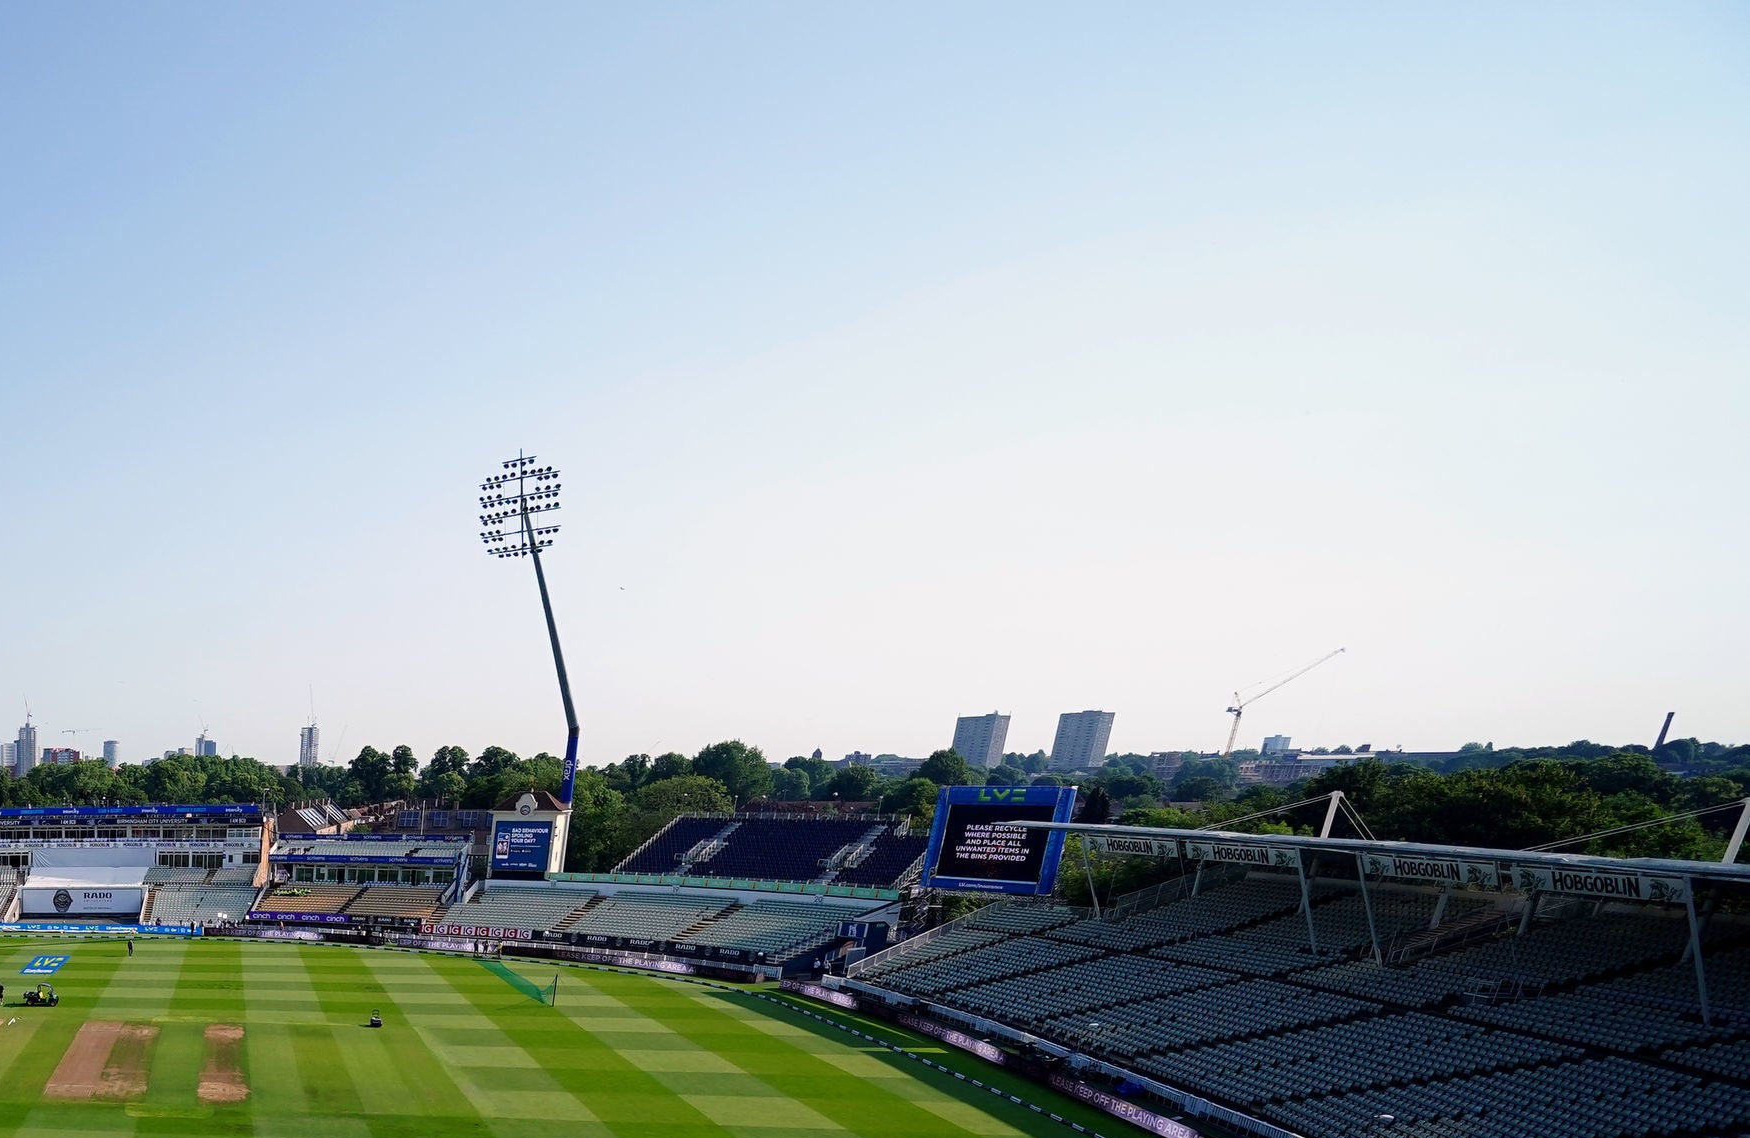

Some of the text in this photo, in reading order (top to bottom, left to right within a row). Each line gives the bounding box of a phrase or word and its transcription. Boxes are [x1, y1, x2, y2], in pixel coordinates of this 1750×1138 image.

[563, 760, 574, 781] drax
[1106, 838, 1153, 855] HOBGOBLIN
[1212, 845, 1269, 864] HOBGOBLIN
[1393, 859, 1461, 882] HOBGOBLIN
[1551, 871, 1640, 898] HOBGOBLIN
[252, 912, 271, 920] cinch
[277, 913, 295, 921] cinch
[301, 914, 320, 922] cinch
[326, 915, 345, 923] cinch
[422, 925, 432, 934] IG
[435, 925, 446, 935] IG
[450, 926, 460, 935] IG
[463, 926, 474, 936] IG
[478, 927, 487, 936] IG
[491, 927, 501, 937] IG
[506, 928, 515, 938] IG
[519, 929, 529, 938] IG
[542, 931, 563, 939] RADO
[587, 935, 607, 943] RADO
[428, 941, 441, 949] THE
[630, 939, 651, 947] RADO
[676, 944, 696, 952] RADO
[720, 948, 740, 957] RADO
[580, 953, 600, 963] KEEP
[602, 955, 617, 964] OFF
[619, 957, 633, 966] THE
[634, 958, 666, 970] PLAYING
[667, 962, 687, 973] AREA
[804, 985, 815, 995] THE
[919, 1020, 933, 1031] KEEP
[933, 1026, 947, 1037] OFF
[946, 1031, 958, 1042] THE
[958, 1036, 982, 1053] PLAYING
[982, 1046, 998, 1058] AREA
[1050, 1074, 1073, 1093] PLEASE
[1074, 1083, 1093, 1101] KEEP
[1094, 1092, 1109, 1107] OFF
[1111, 1098, 1127, 1115] THE
[1128, 1106, 1162, 1130] PLAYING
